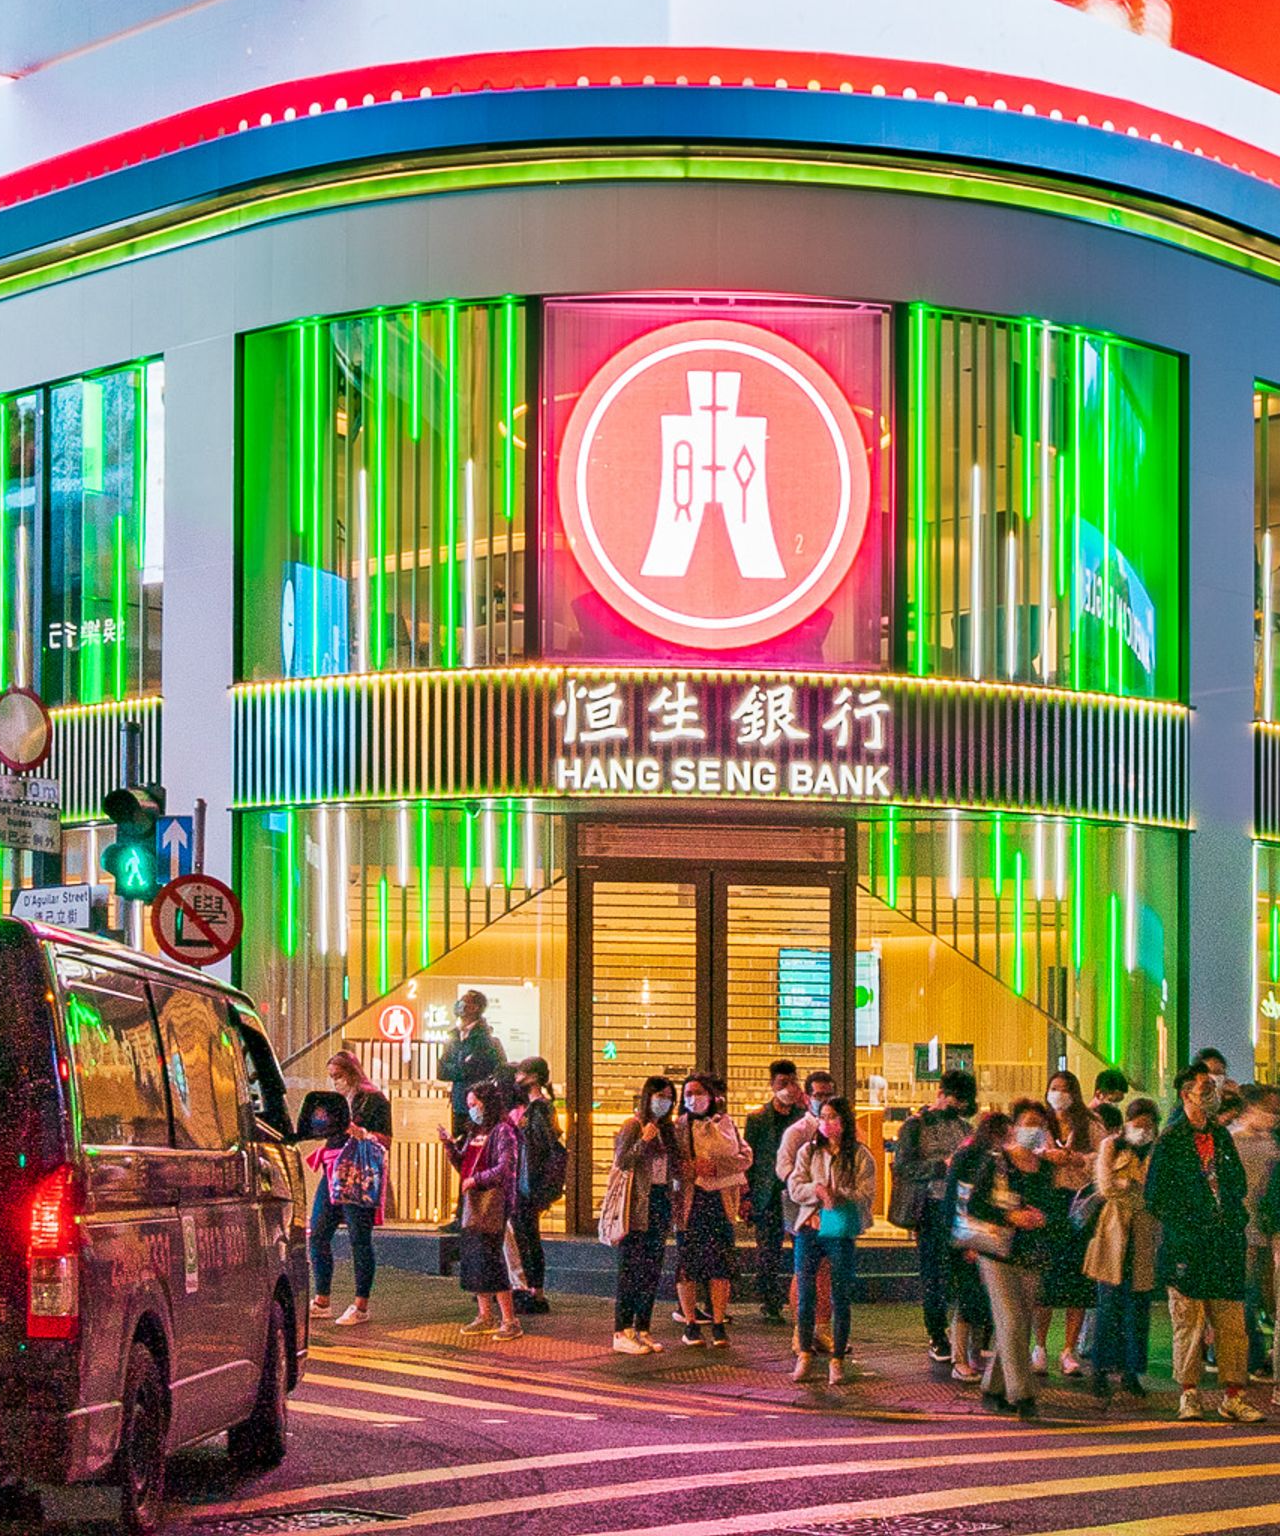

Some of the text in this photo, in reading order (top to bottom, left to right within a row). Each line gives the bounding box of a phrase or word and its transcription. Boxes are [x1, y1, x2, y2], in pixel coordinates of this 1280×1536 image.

[554, 679, 891, 751] 恒生銀行
[557, 757, 891, 796] HANG SENG BANK
[23, 890, 89, 909] D'Aguilar Street
